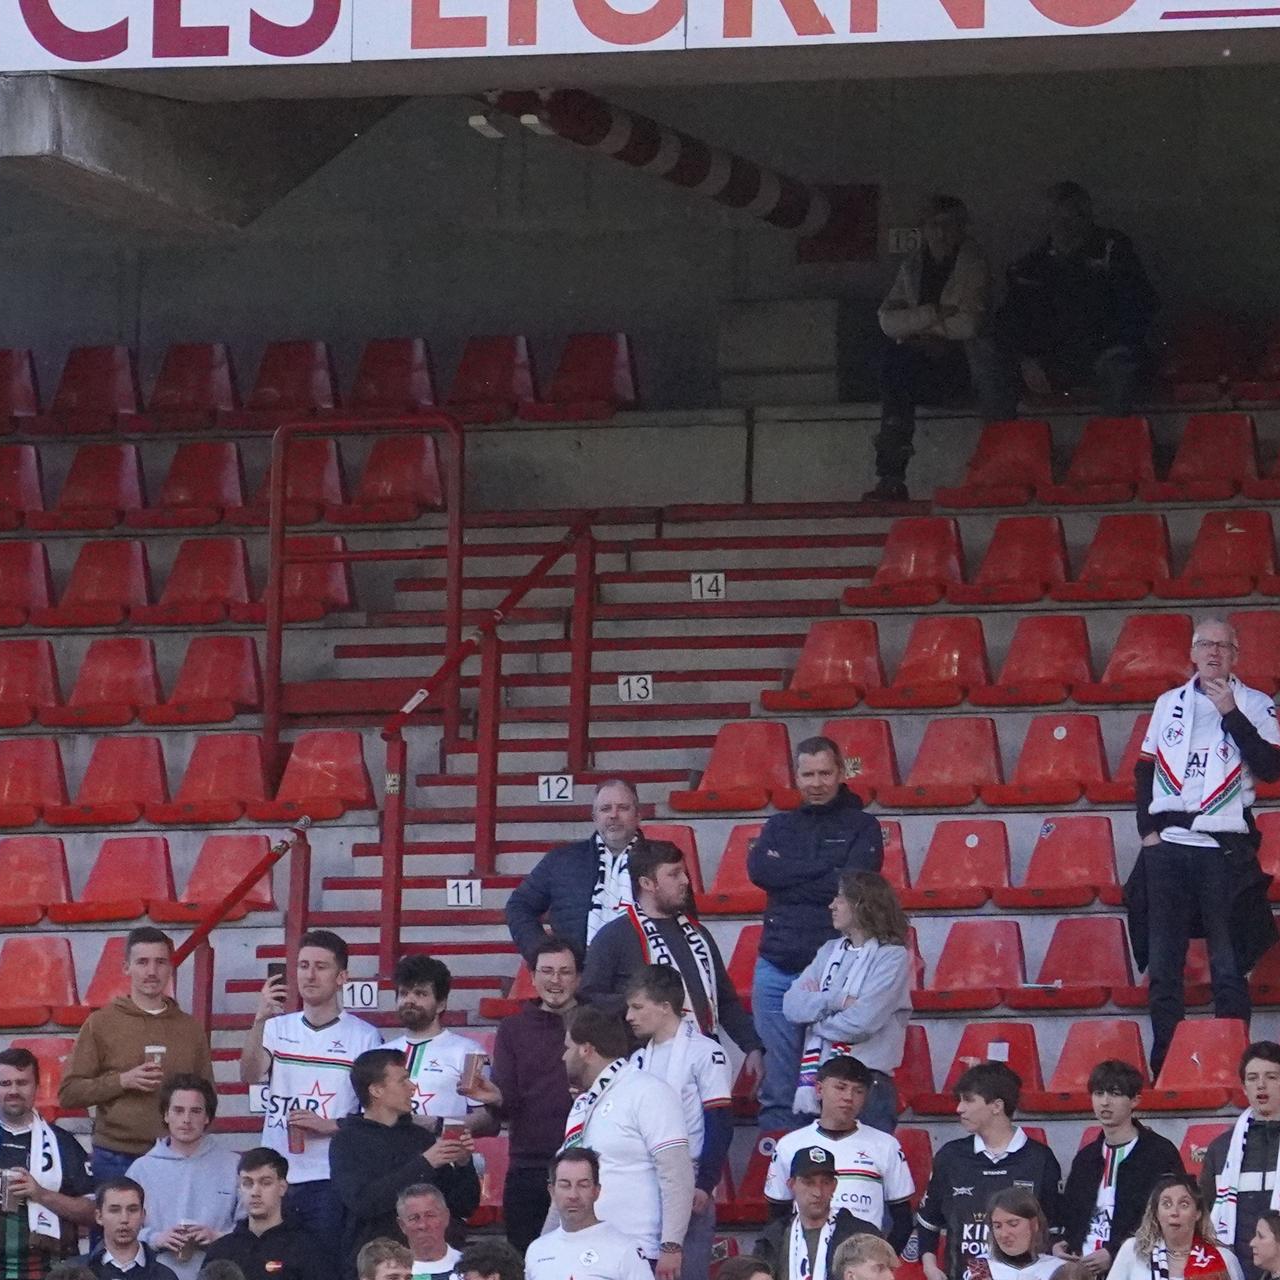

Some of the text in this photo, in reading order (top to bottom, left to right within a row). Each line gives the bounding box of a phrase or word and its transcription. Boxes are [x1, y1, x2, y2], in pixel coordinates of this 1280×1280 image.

[694, 575, 722, 598] 14
[623, 676, 652, 699] 13
[543, 776, 570, 800] 12
[452, 882, 476, 905] 11
[348, 983, 374, 1006] 10
